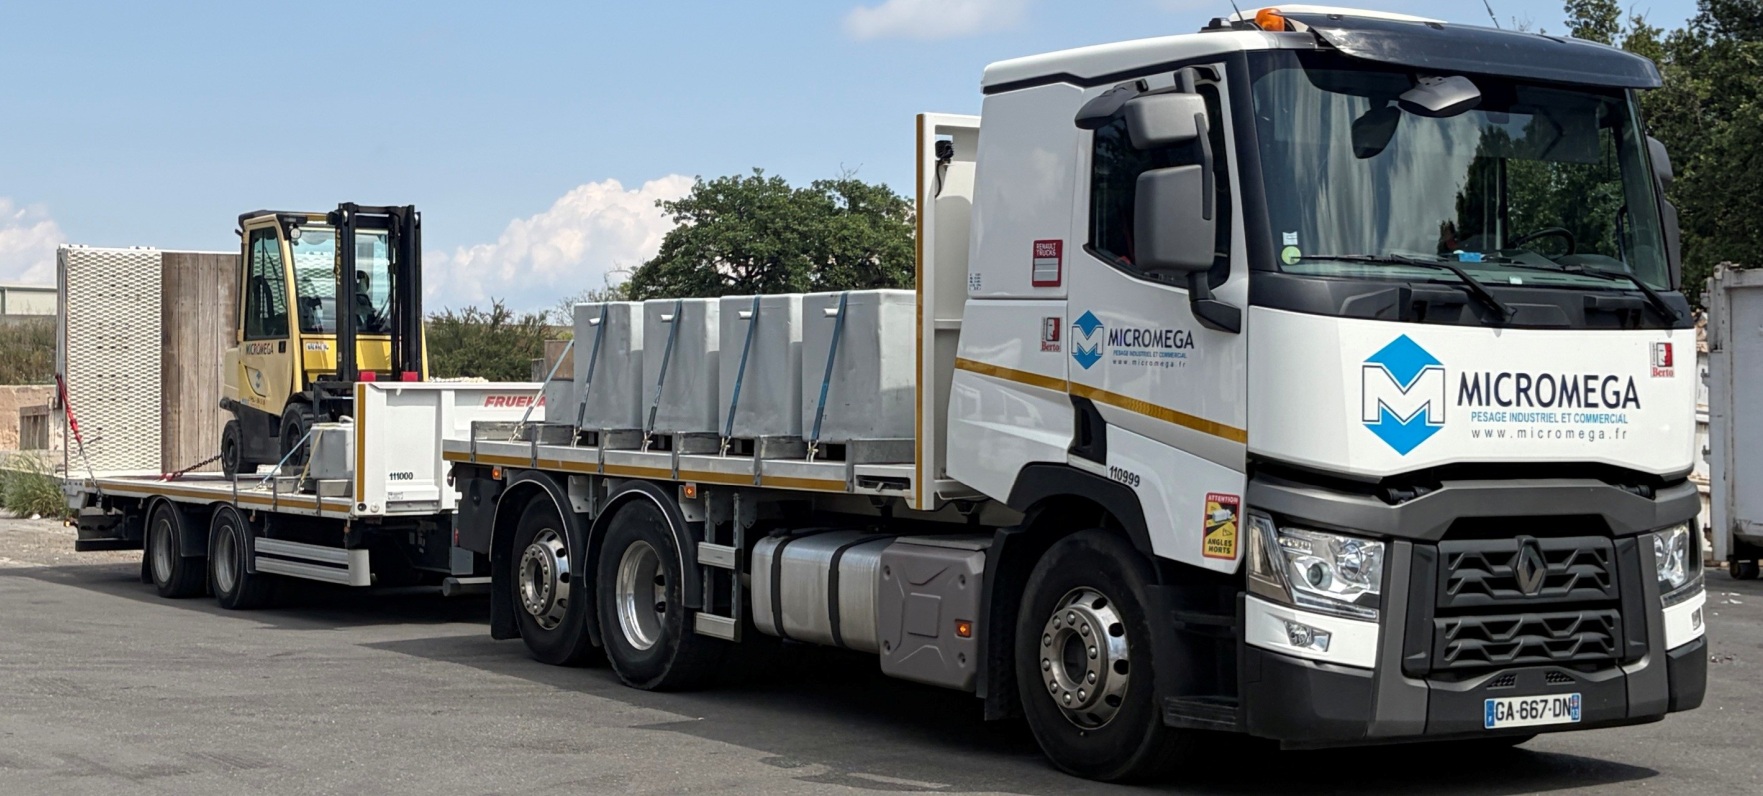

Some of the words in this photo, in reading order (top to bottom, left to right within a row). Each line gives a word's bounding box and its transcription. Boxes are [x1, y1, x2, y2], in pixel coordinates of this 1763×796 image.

[1107, 328, 1194, 349] MICROMEGA
[245, 342, 274, 355] MICROMEGA
[1041, 341, 1060, 352] Berto
[1112, 360, 1186, 369] www.micromega.fr
[1652, 367, 1674, 377] Berto
[1457, 371, 1641, 410] MICROMEGA
[1471, 411, 1507, 423] PESAGE
[1508, 411, 1560, 424] INDUSTRIEL
[1561, 413, 1572, 423] ET
[1573, 412, 1629, 424] COMMERCIAL
[1471, 427, 1628, 442] www.micromega.fr
[389, 472, 414, 480] 111000
[1109, 466, 1140, 487] 110999
[1208, 495, 1238, 503] ATTENTION
[1207, 538, 1232, 547] ANGLES
[1208, 545, 1231, 554] MORTS
